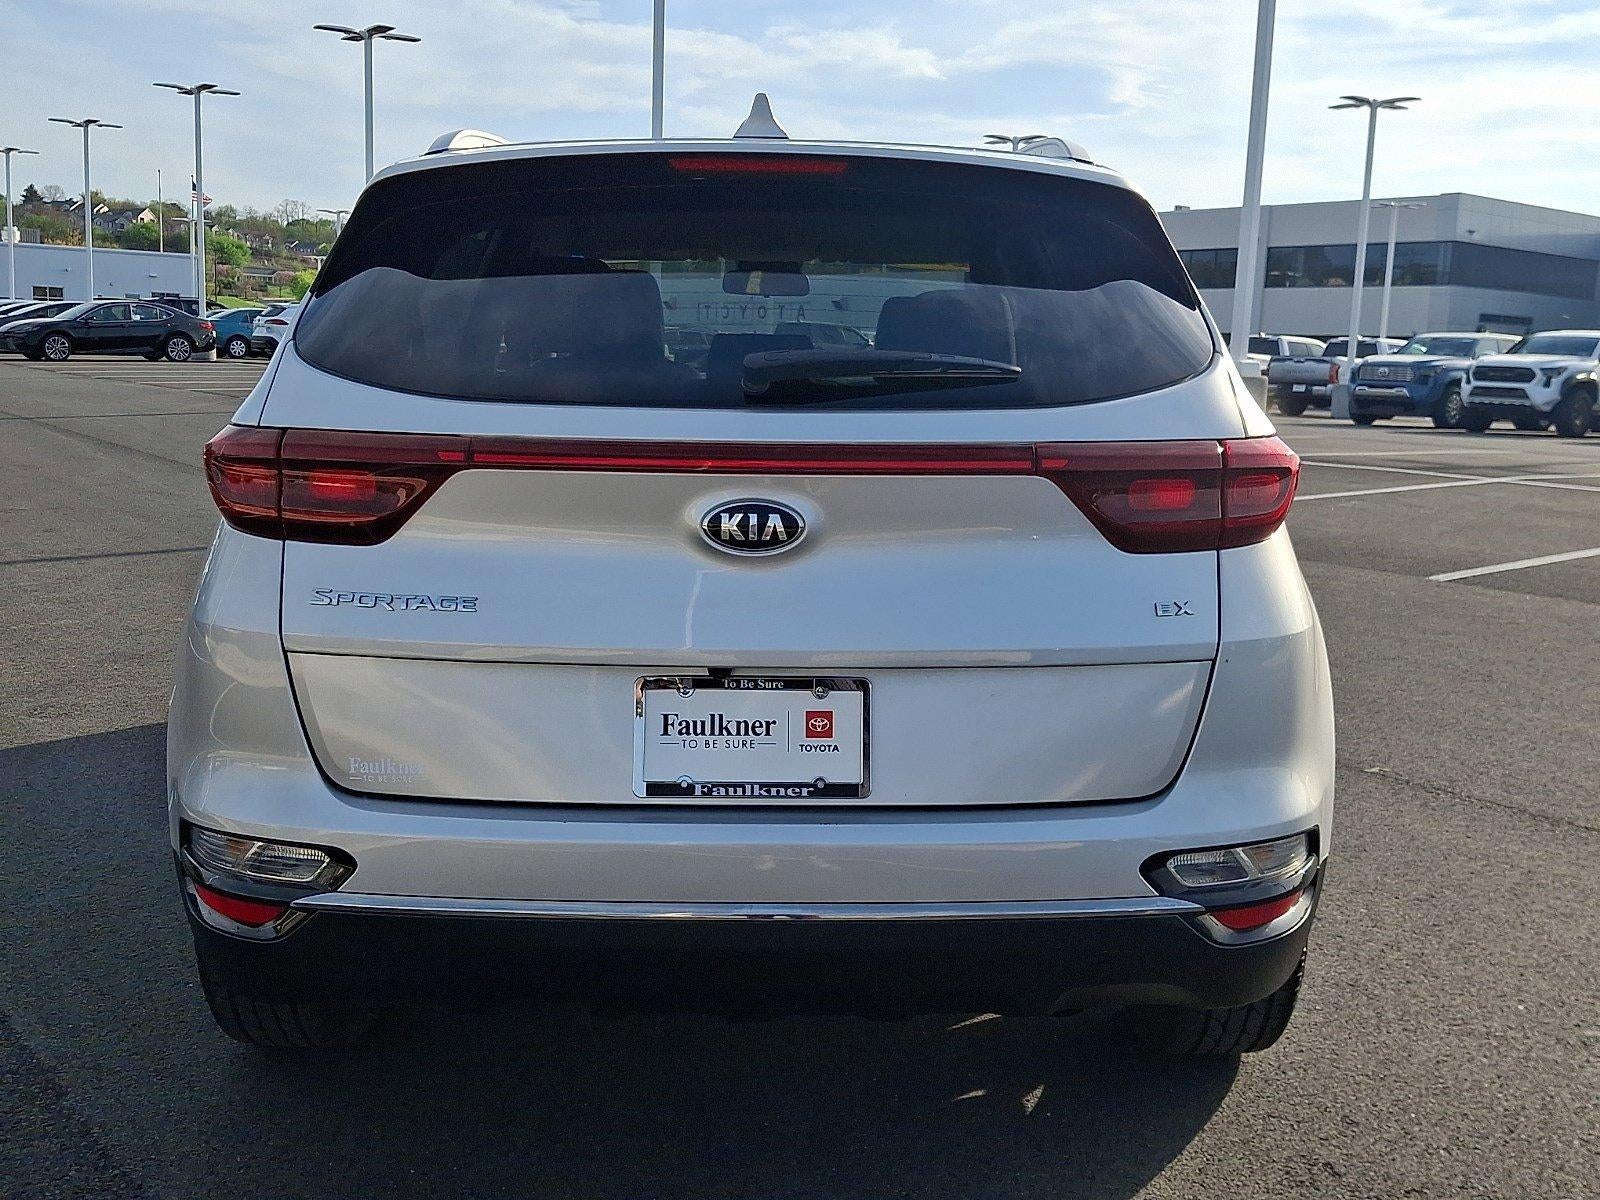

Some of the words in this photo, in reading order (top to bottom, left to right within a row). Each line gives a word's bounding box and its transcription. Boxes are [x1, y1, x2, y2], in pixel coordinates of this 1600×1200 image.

[720, 512, 788, 541] KIA
[1153, 600, 1195, 617] EX
[722, 679, 737, 689] To
[739, 679, 755, 690] Be
[757, 679, 784, 690] Sure
[660, 713, 777, 737] Faulkner
[681, 739, 698, 749] TO
[704, 739, 719, 749] BE
[725, 739, 756, 749] SURE
[799, 743, 840, 753] TOYOTA
[694, 783, 814, 797] Faulkner
